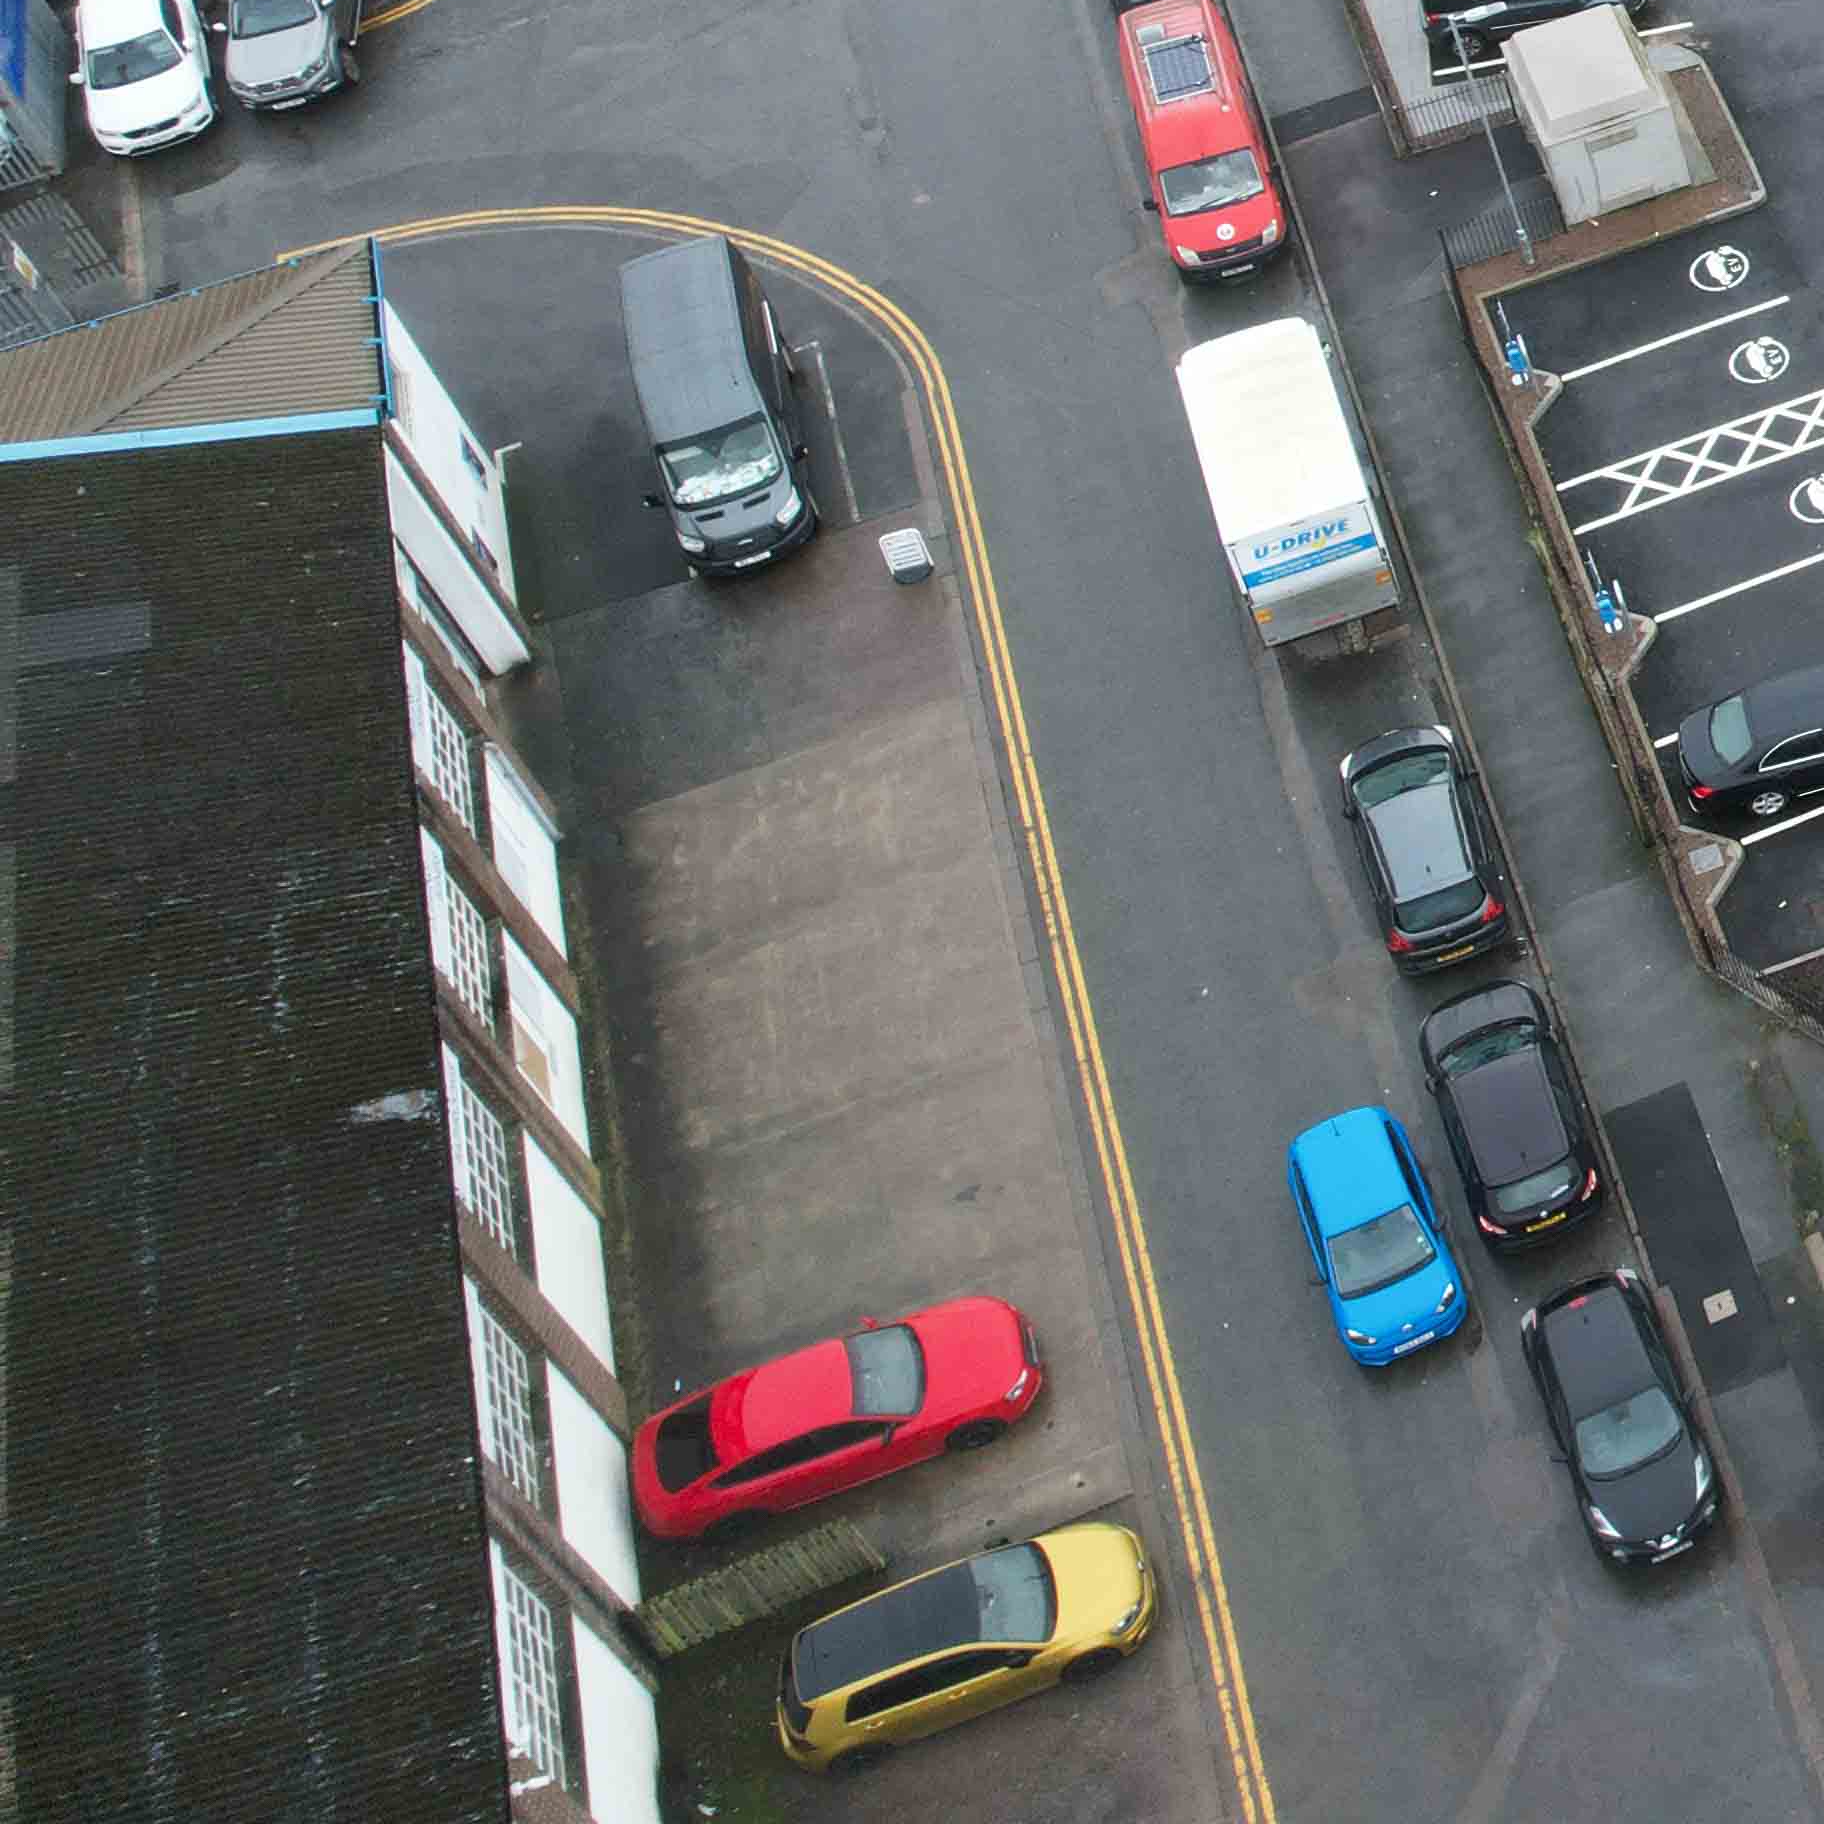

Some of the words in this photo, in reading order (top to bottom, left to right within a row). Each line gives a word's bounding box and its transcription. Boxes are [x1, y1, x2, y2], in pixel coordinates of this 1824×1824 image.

[1727, 257, 1743, 273] EV
[1766, 348, 1785, 365] EV
[1252, 517, 1354, 561] U-DRIVE
